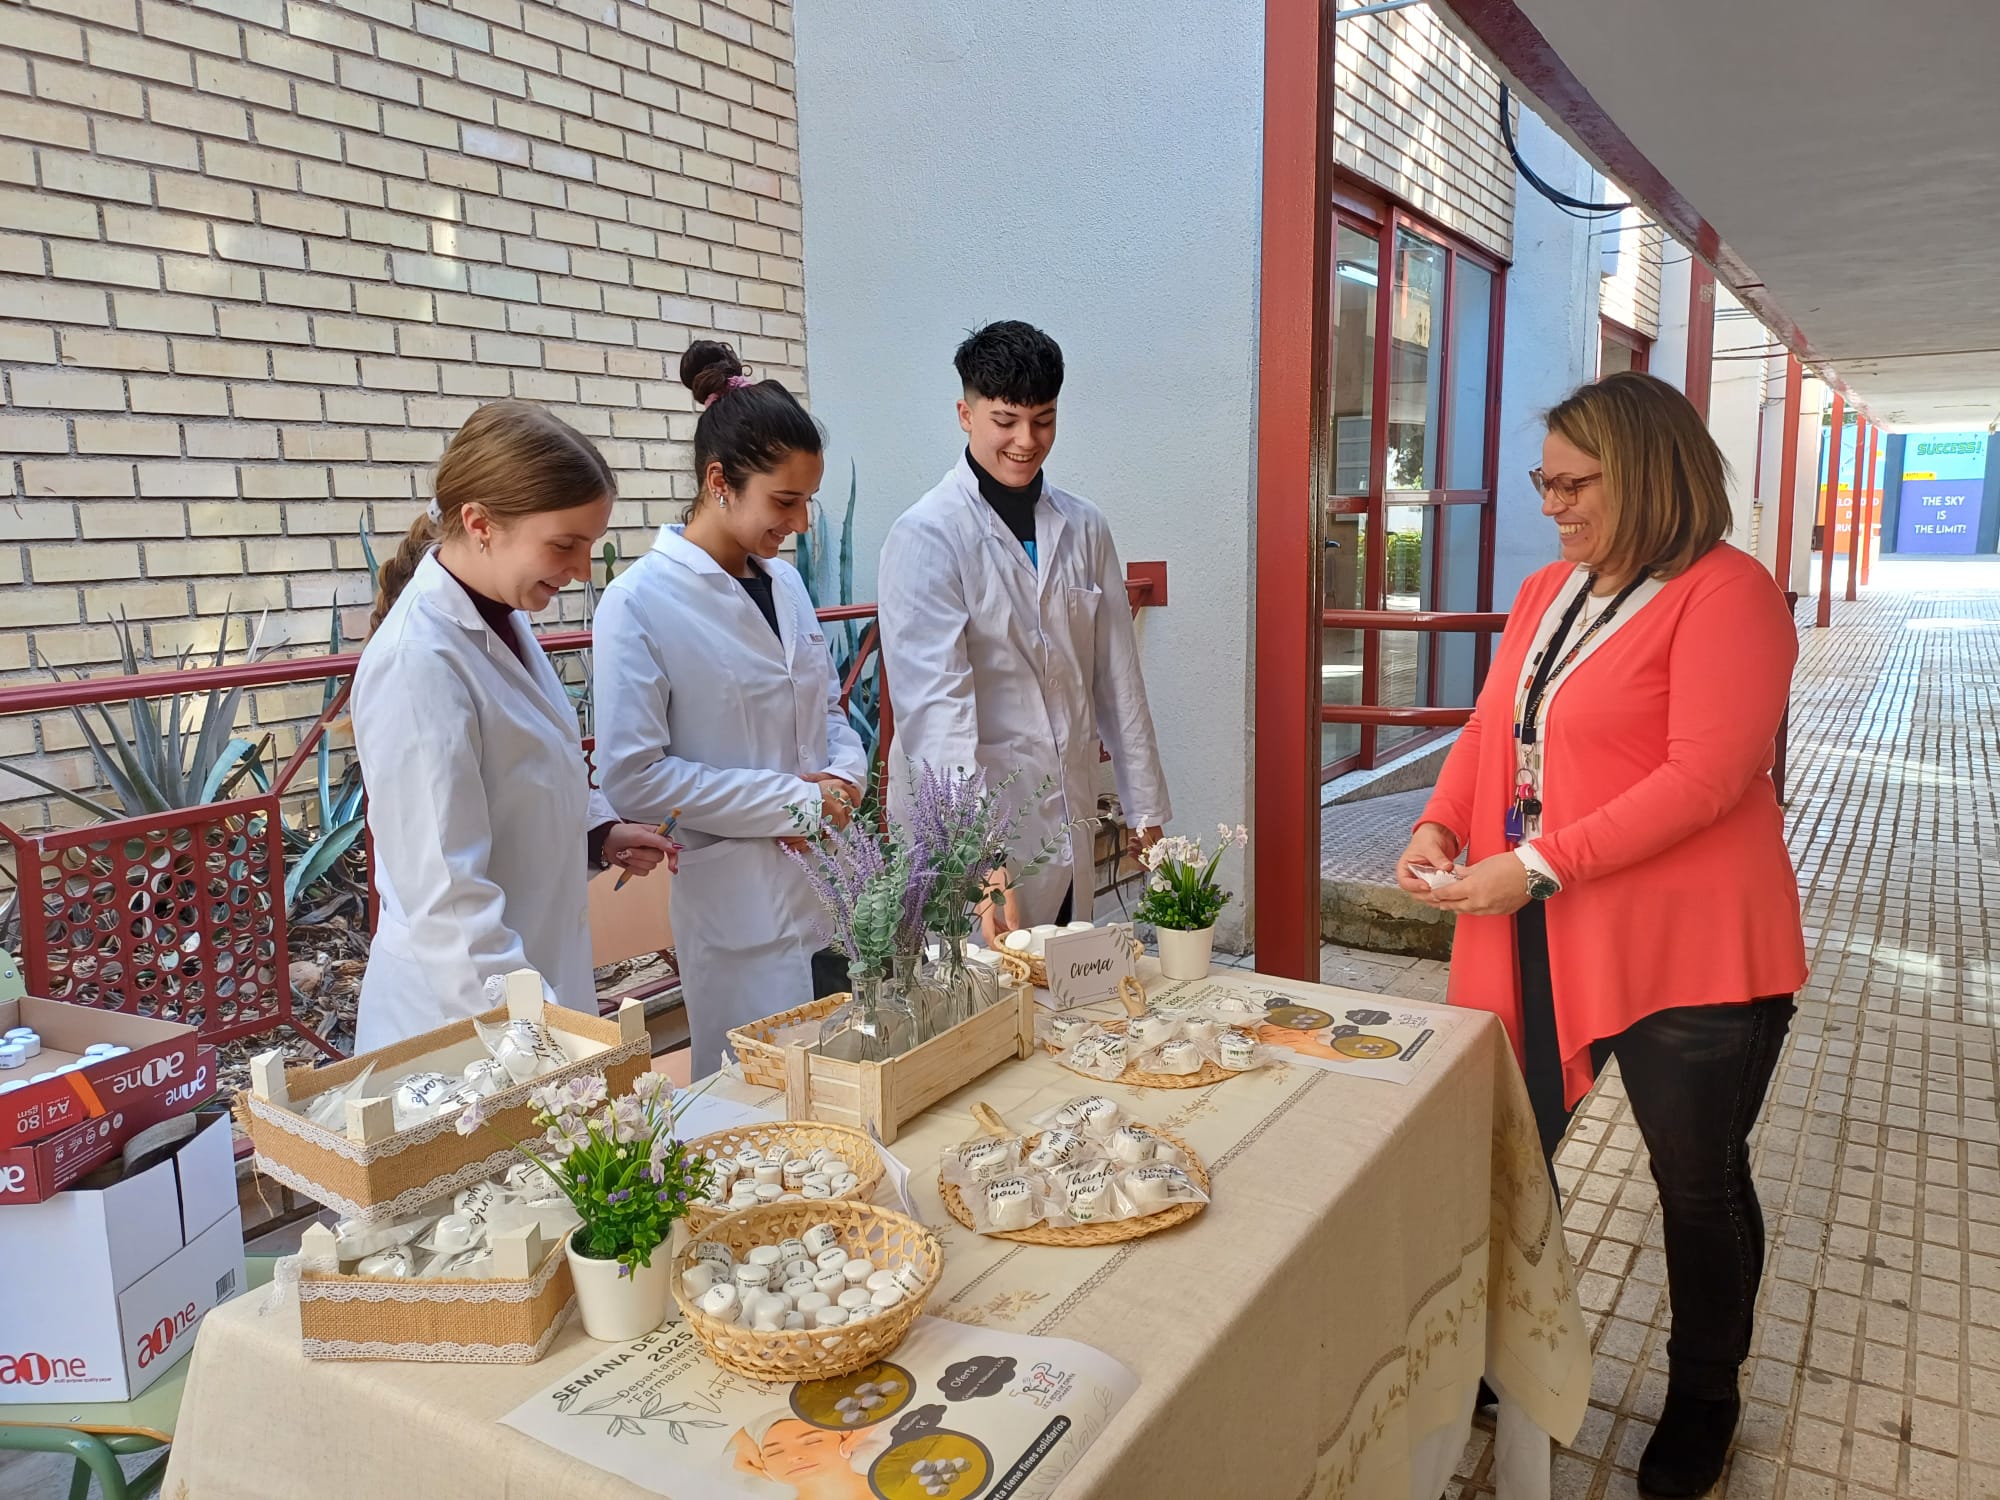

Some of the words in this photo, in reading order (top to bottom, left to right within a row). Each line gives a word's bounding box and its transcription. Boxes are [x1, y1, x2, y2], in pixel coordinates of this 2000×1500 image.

[1917, 441, 1982, 456] SUCCESS!
[1922, 496, 1943, 506] THE
[1944, 496, 1965, 506] SKY
[1936, 510, 1947, 520] IS
[1914, 524, 1934, 534] THE
[1935, 524, 1967, 534] LIMIT!
[17, 1104, 39, 1119] gsm
[47, 1099, 70, 1113] A4
[17, 1118, 40, 1133] 80
[1065, 1162, 1115, 1189] Thank
[1070, 1177, 1105, 1203] you!
[647, 1331, 694, 1364] 2025
[551, 1352, 635, 1402] SEMANA
[630, 1335, 660, 1353] DE
[656, 1318, 684, 1337] LA
[616, 1339, 704, 1400] Departamento
[950, 1364, 979, 1388] Oferta
[684, 1370, 745, 1414] Venta
[1002, 1470, 1024, 1491] tiene
[1018, 1452, 1039, 1472] fines
[1036, 1419, 1068, 1454] solidarios
